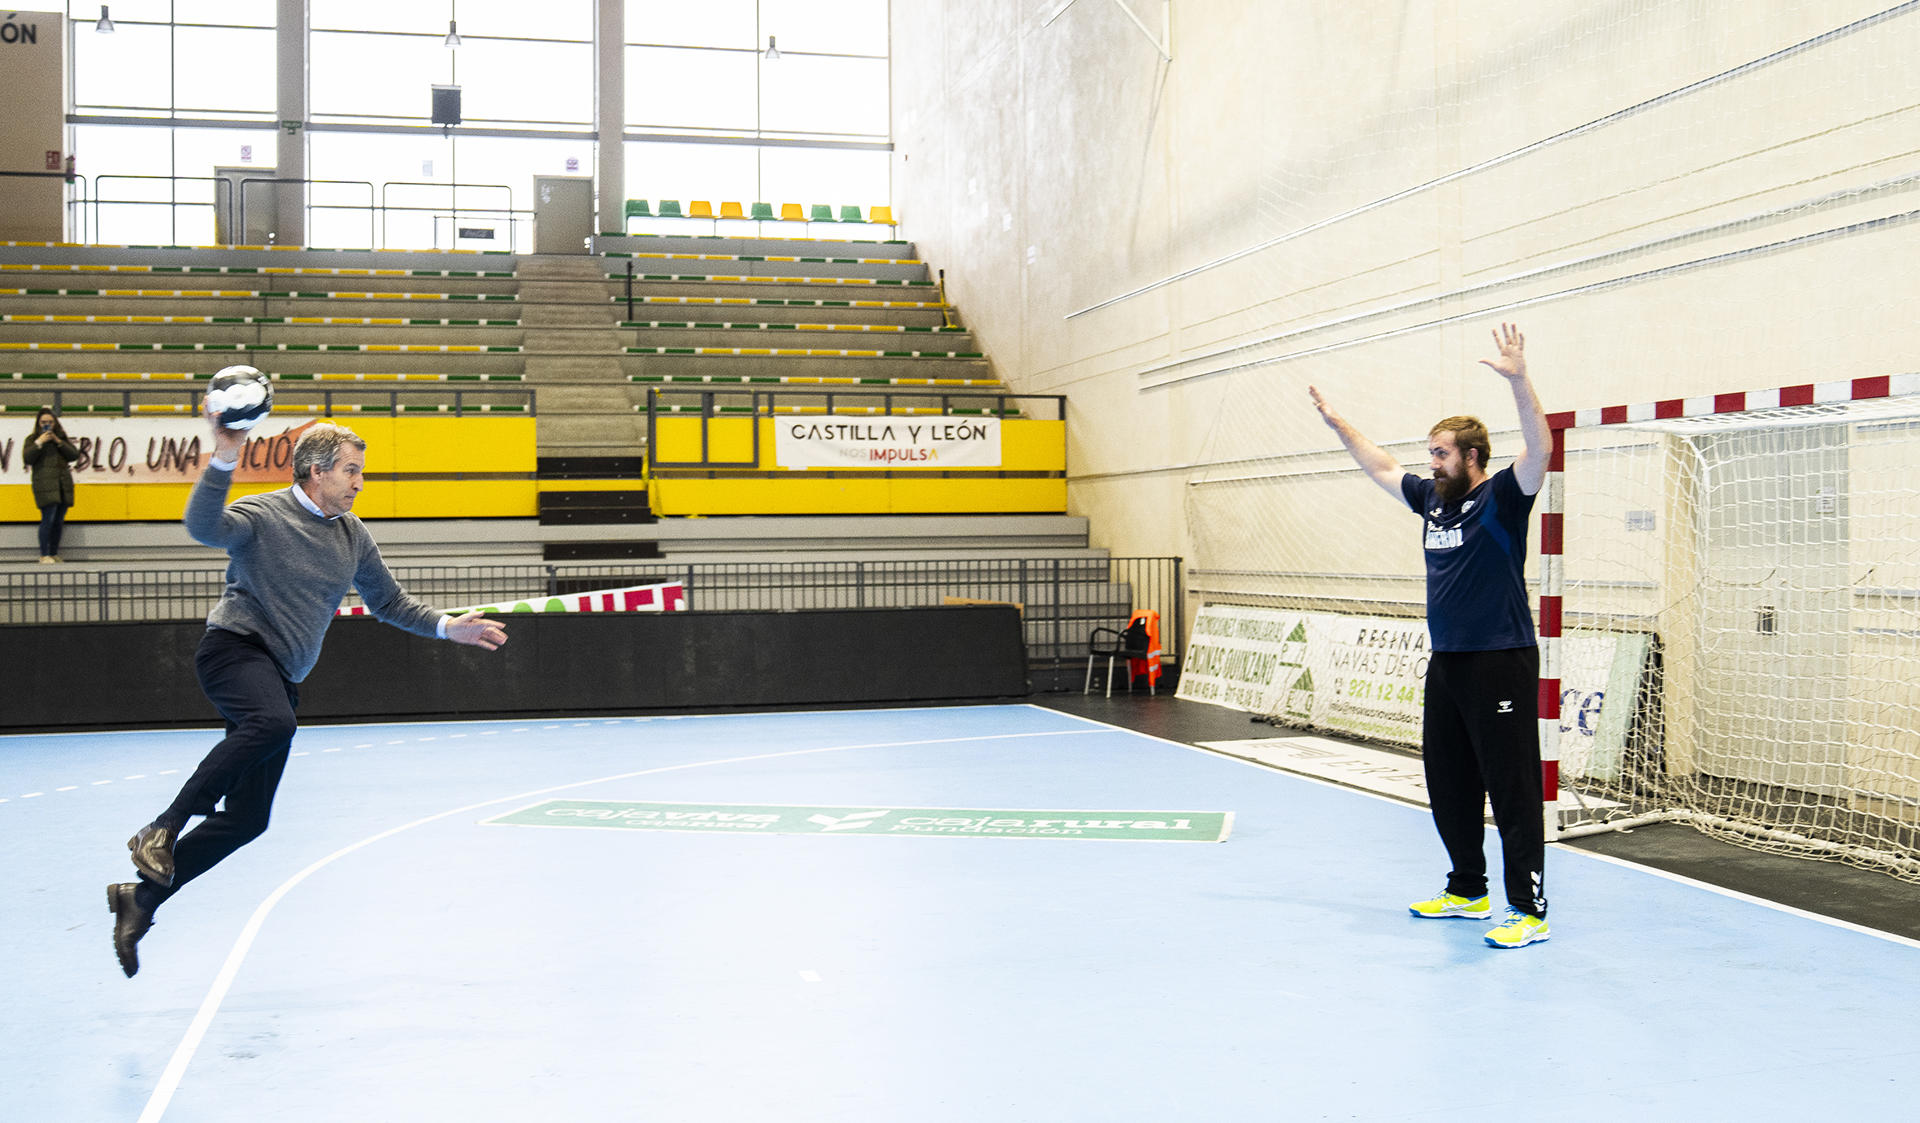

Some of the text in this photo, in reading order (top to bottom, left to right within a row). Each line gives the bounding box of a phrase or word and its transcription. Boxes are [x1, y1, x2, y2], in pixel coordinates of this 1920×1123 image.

[791, 420, 986, 444] CASTILLA Y LEÓN
[146, 435, 200, 473] UNA
[1329, 649, 1380, 675] NAVAS
[1348, 679, 1373, 698] 921
[1376, 683, 1394, 701] 12
[900, 815, 1193, 830] cajarural
